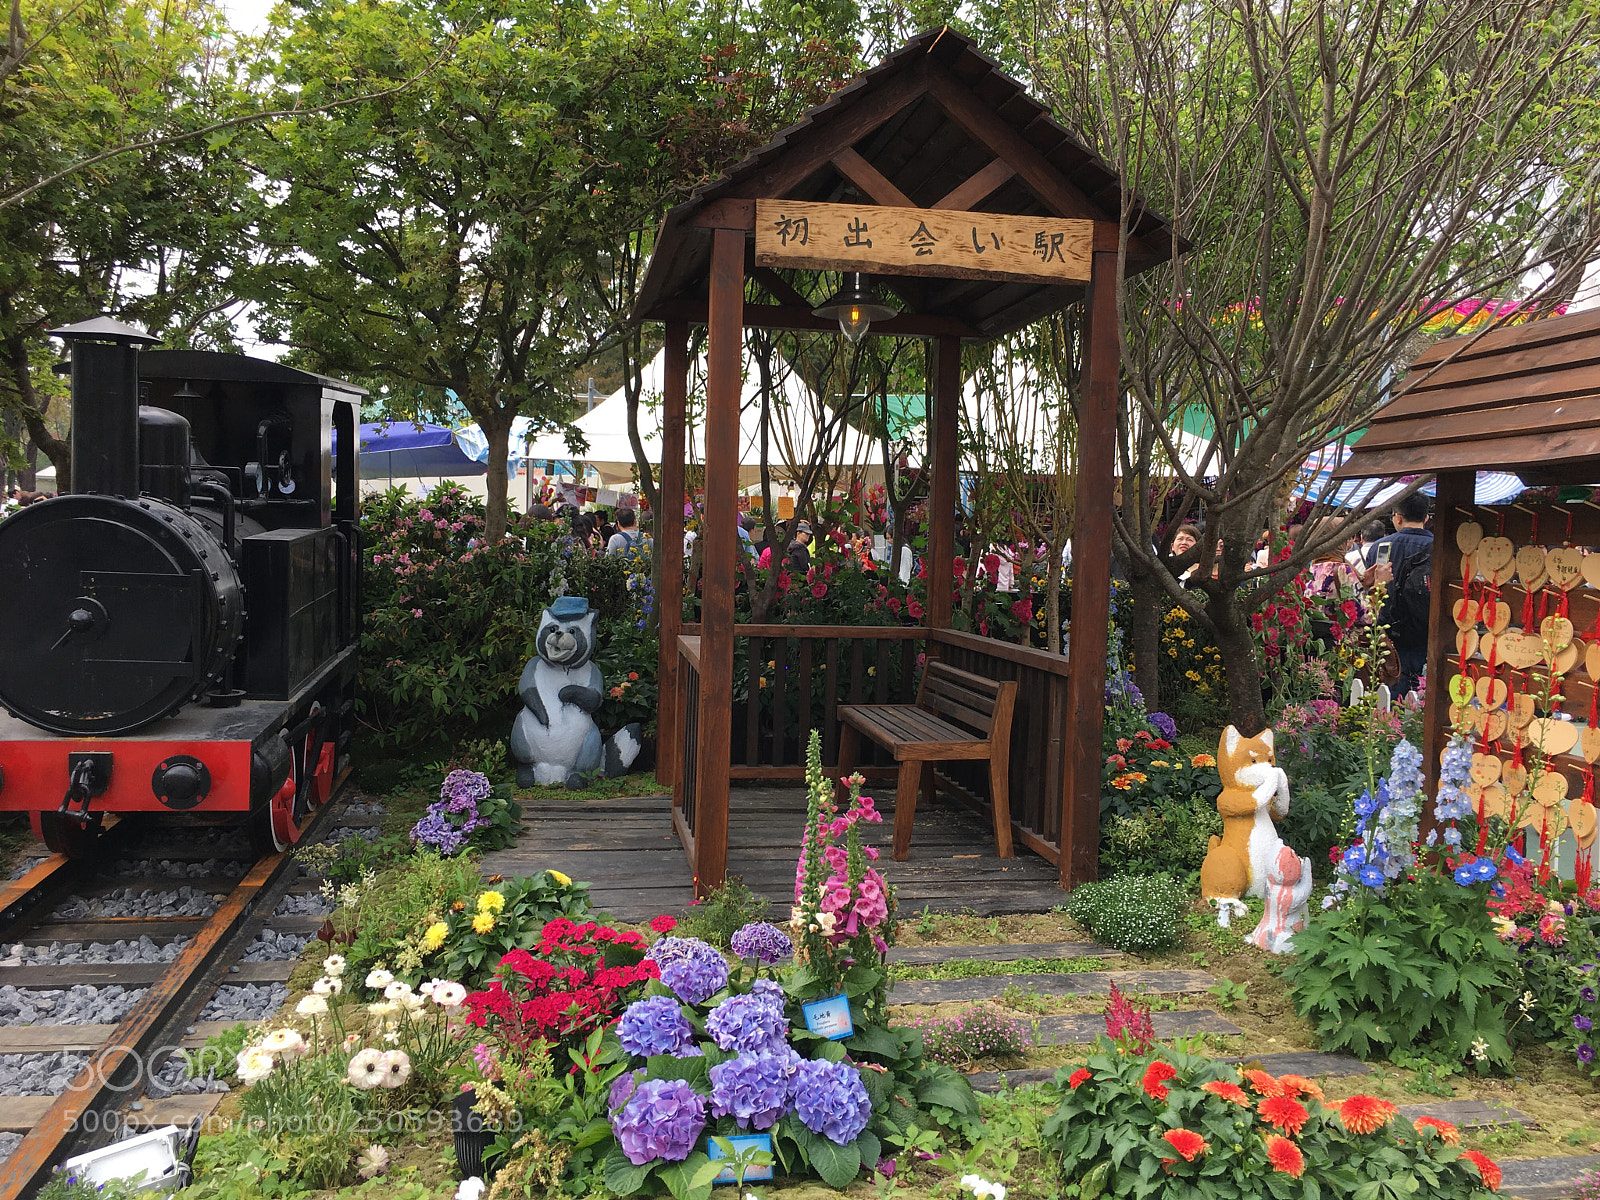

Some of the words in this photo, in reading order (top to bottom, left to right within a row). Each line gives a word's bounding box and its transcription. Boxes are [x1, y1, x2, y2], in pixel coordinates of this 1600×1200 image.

[774, 213, 1066, 264] 初出会い駅
